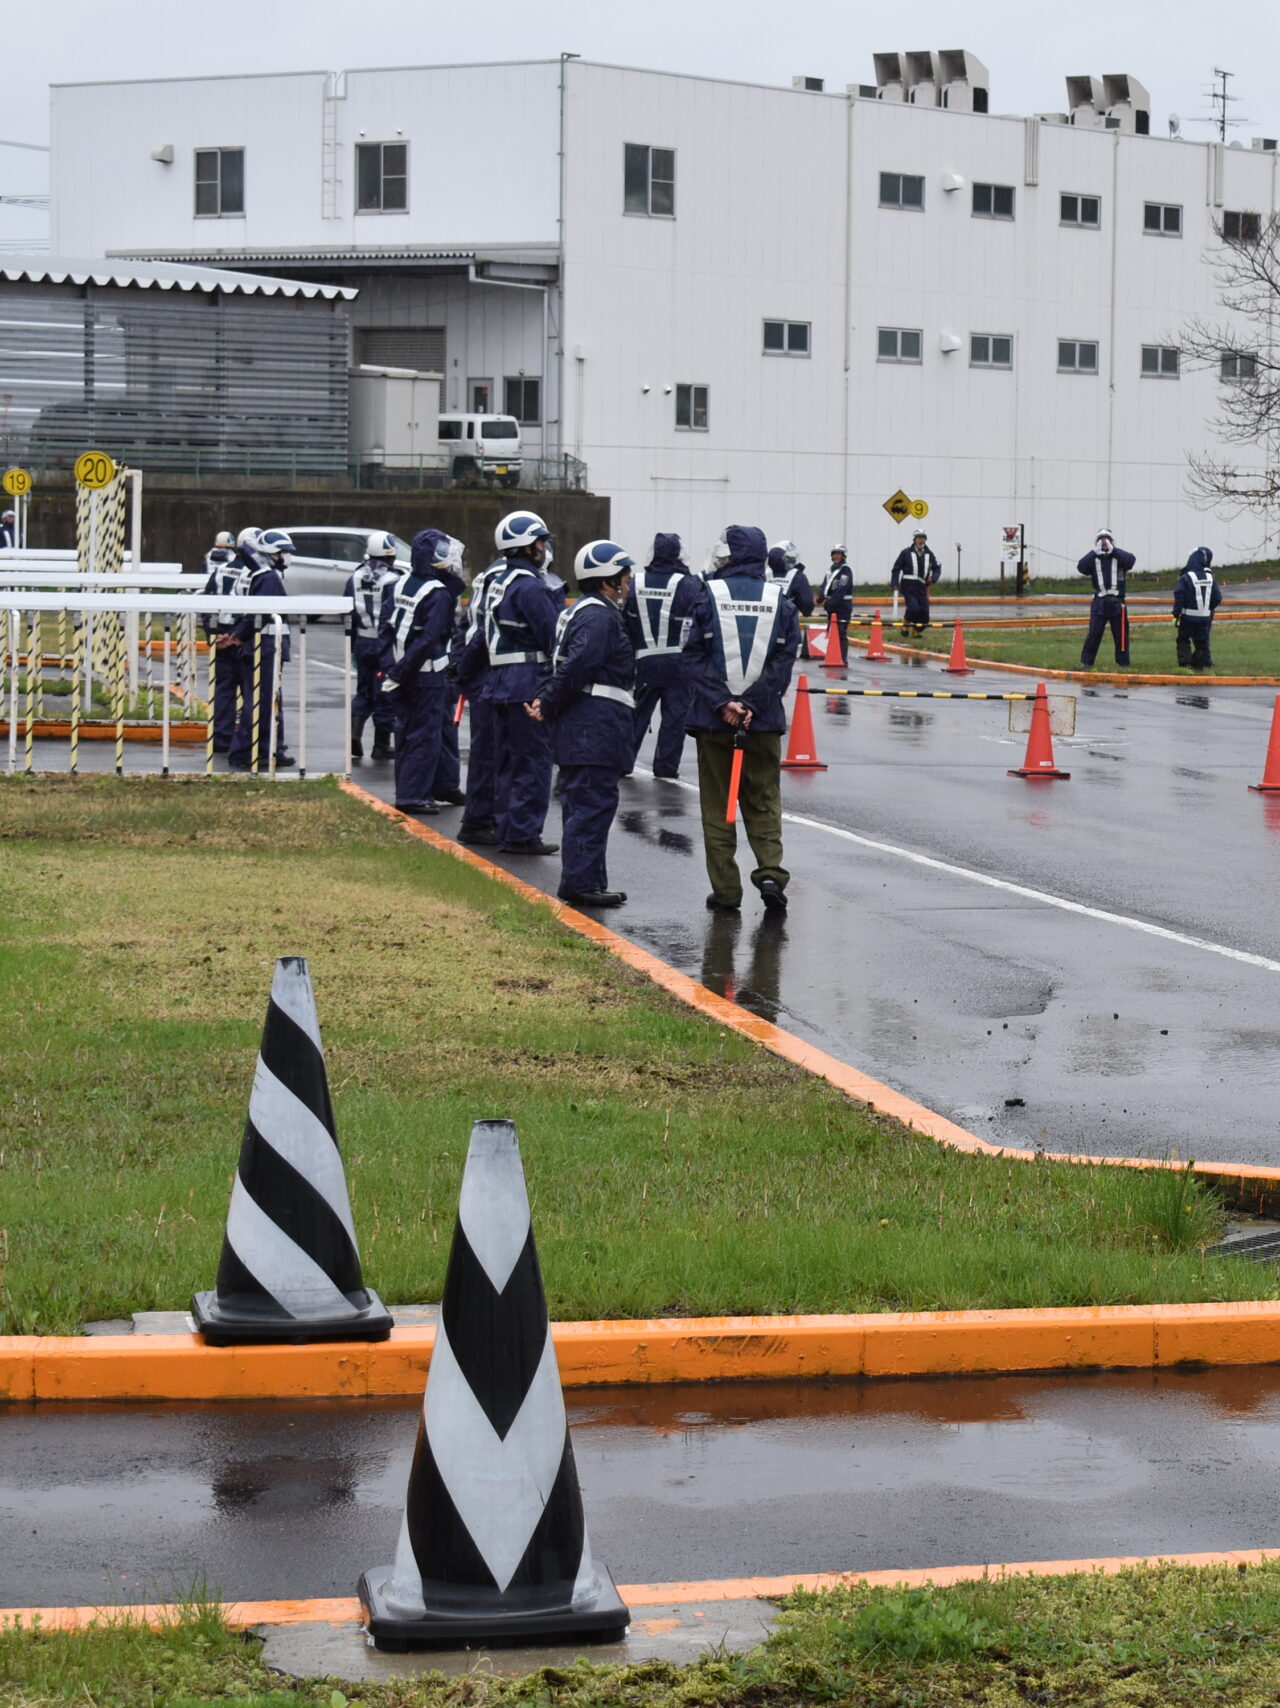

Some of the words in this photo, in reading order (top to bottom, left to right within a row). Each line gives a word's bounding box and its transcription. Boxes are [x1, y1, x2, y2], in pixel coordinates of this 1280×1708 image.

[83, 458, 107, 483] 20
[9, 473, 26, 491] 19
[914, 502, 924, 516] 9
